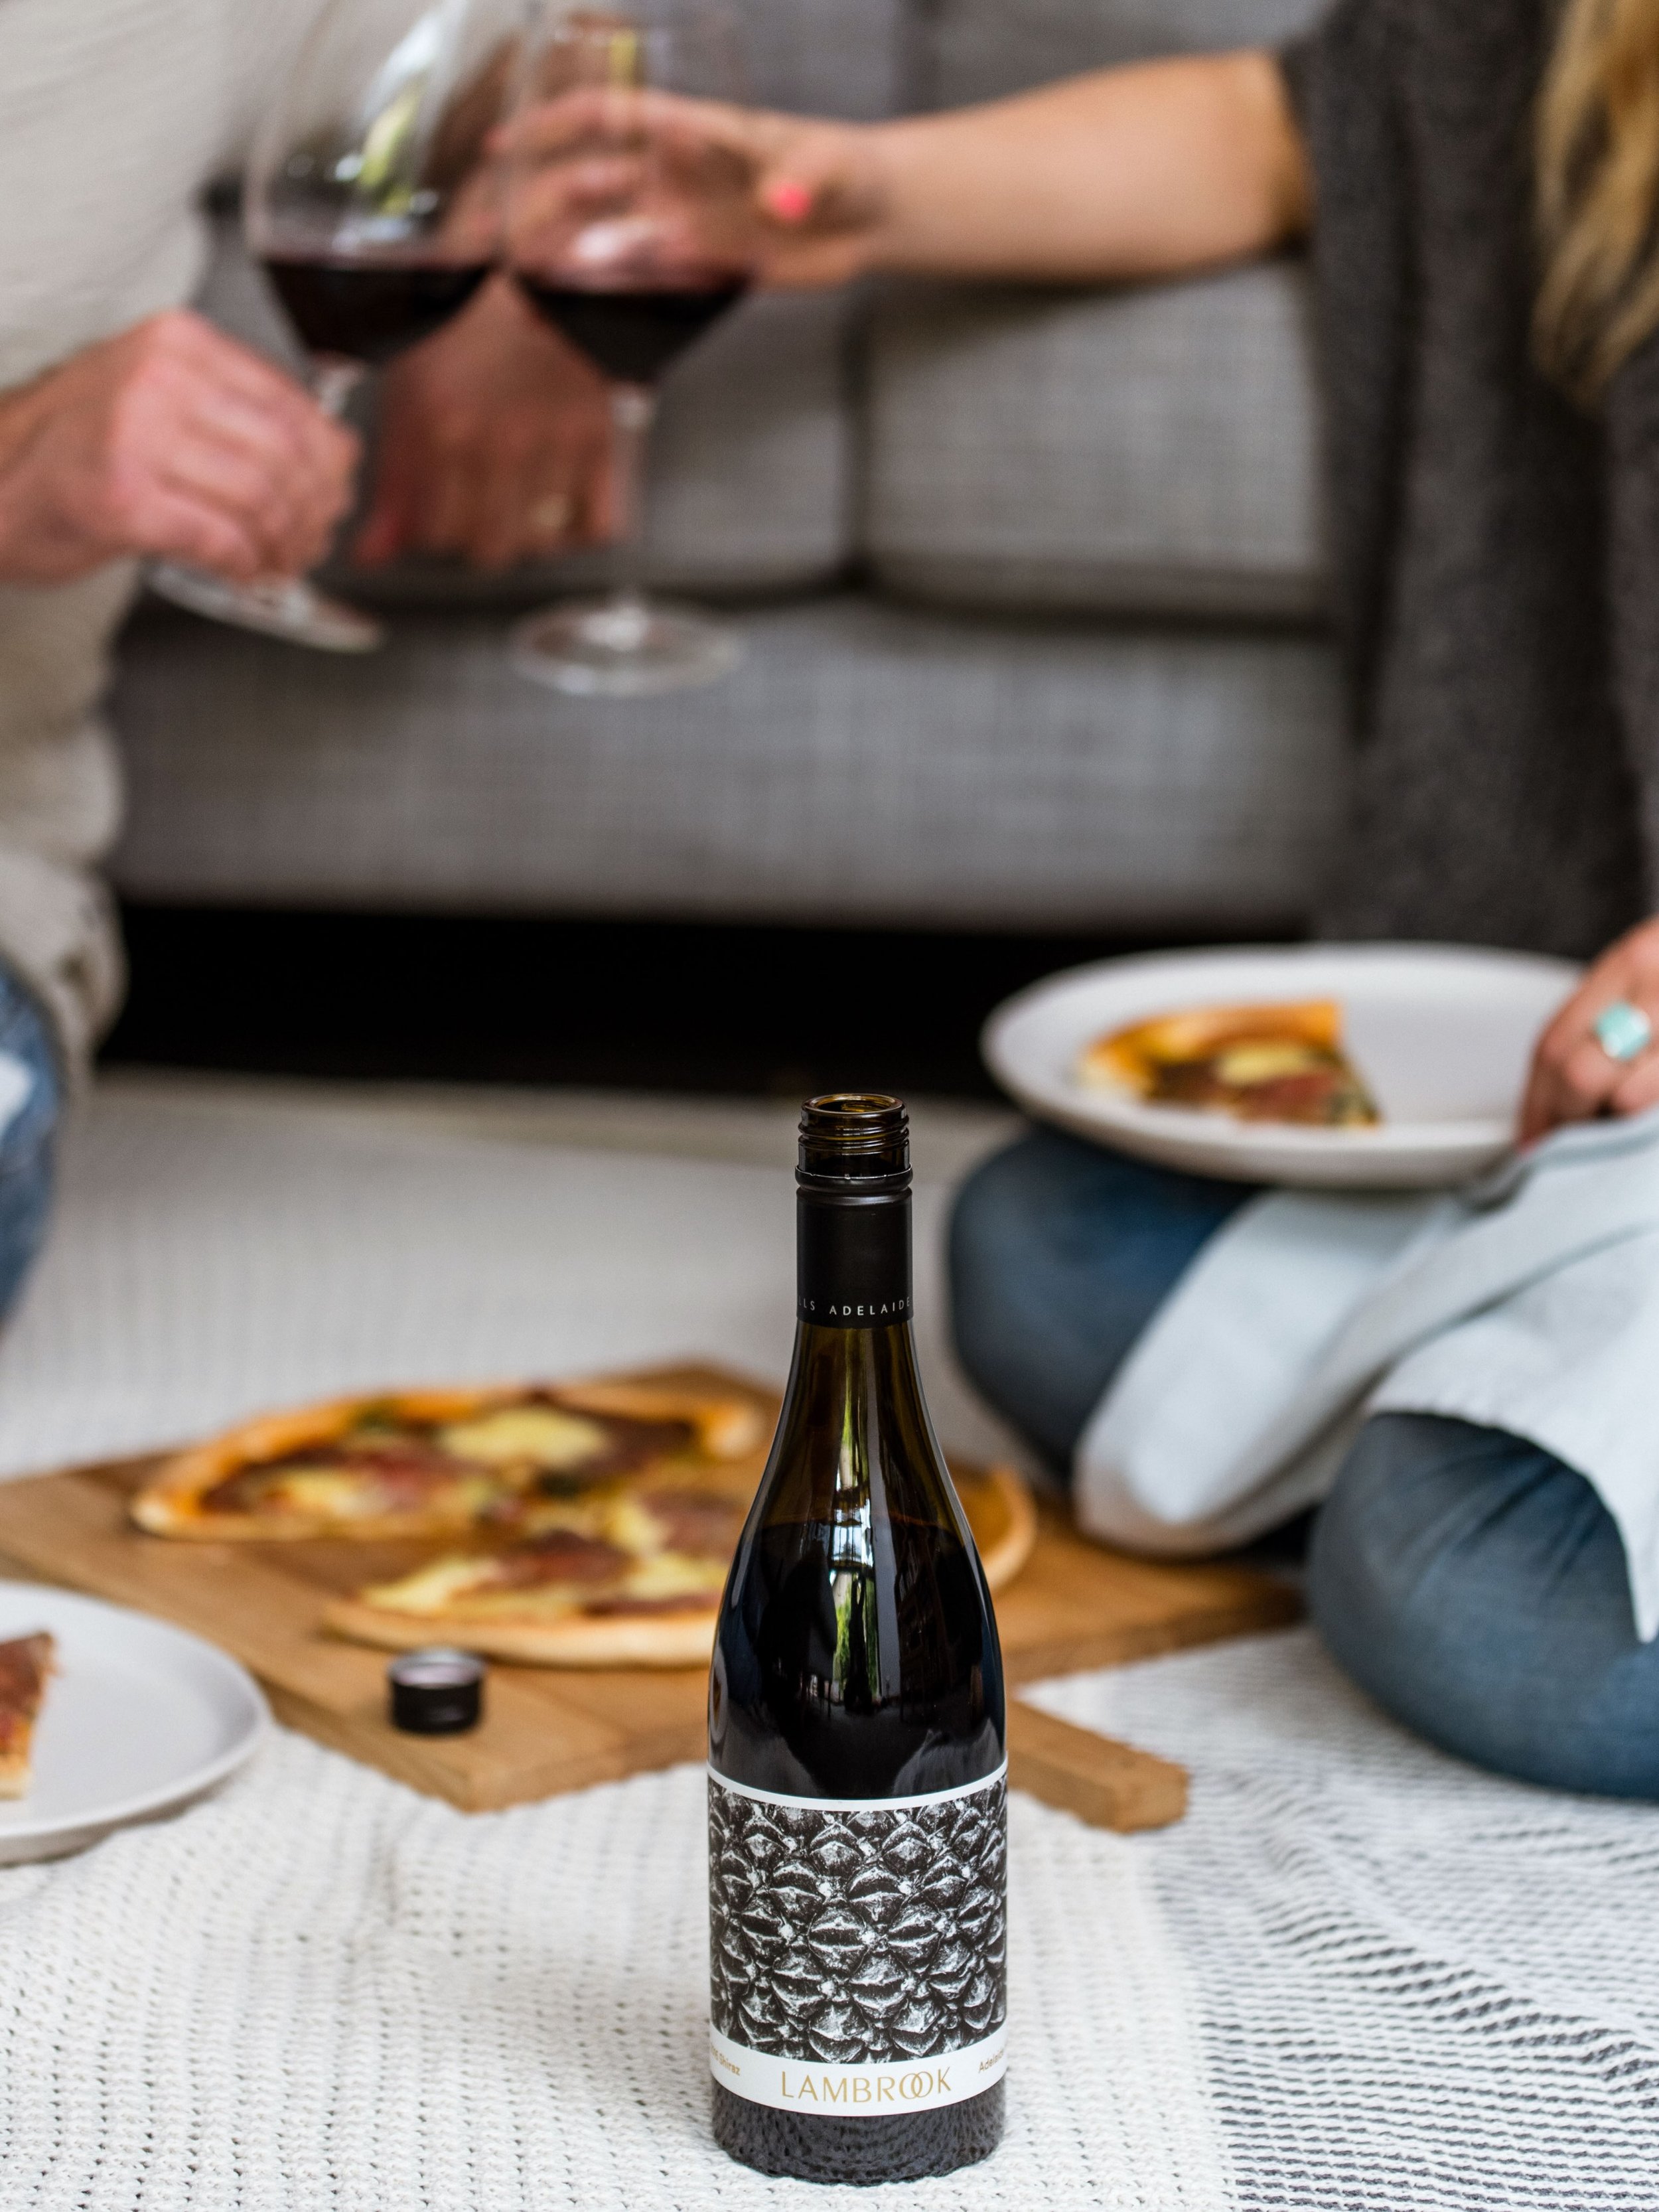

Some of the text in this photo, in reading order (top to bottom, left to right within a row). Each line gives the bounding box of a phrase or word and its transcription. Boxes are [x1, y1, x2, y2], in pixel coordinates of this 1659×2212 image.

[829, 1296, 910, 1316] ADELAIDE
[719, 2053, 741, 2076] Shiraz
[781, 2066, 952, 2103] LAMBROOK
